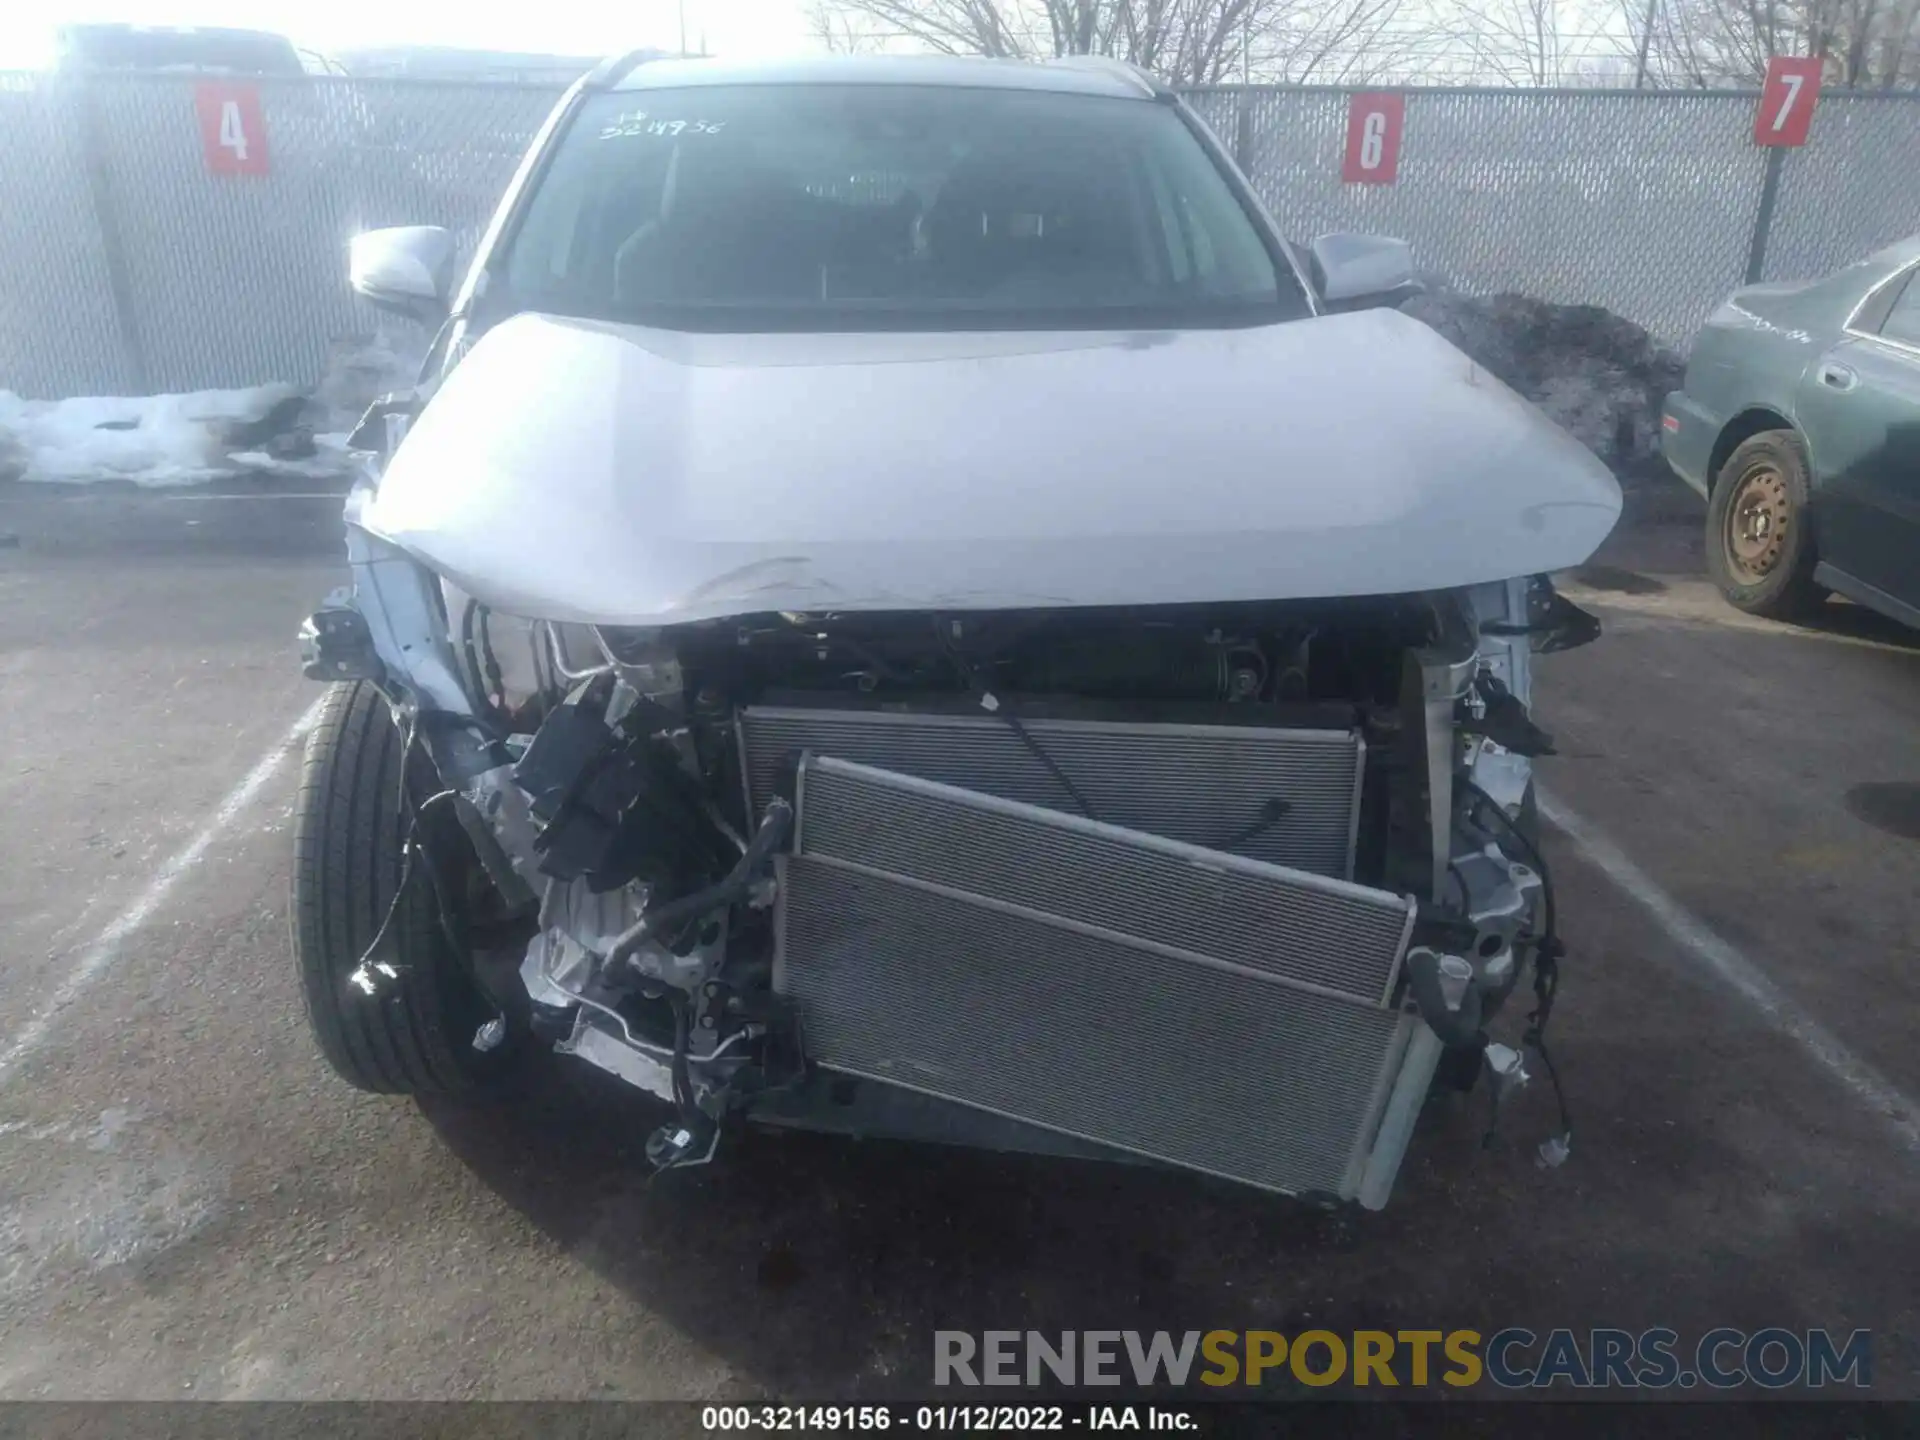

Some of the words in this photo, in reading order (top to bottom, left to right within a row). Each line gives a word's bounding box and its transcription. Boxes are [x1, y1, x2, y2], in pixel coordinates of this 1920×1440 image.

[220, 100, 248, 160] 4
[1772, 74, 1804, 131] 7
[1361, 112, 1386, 169] 6
